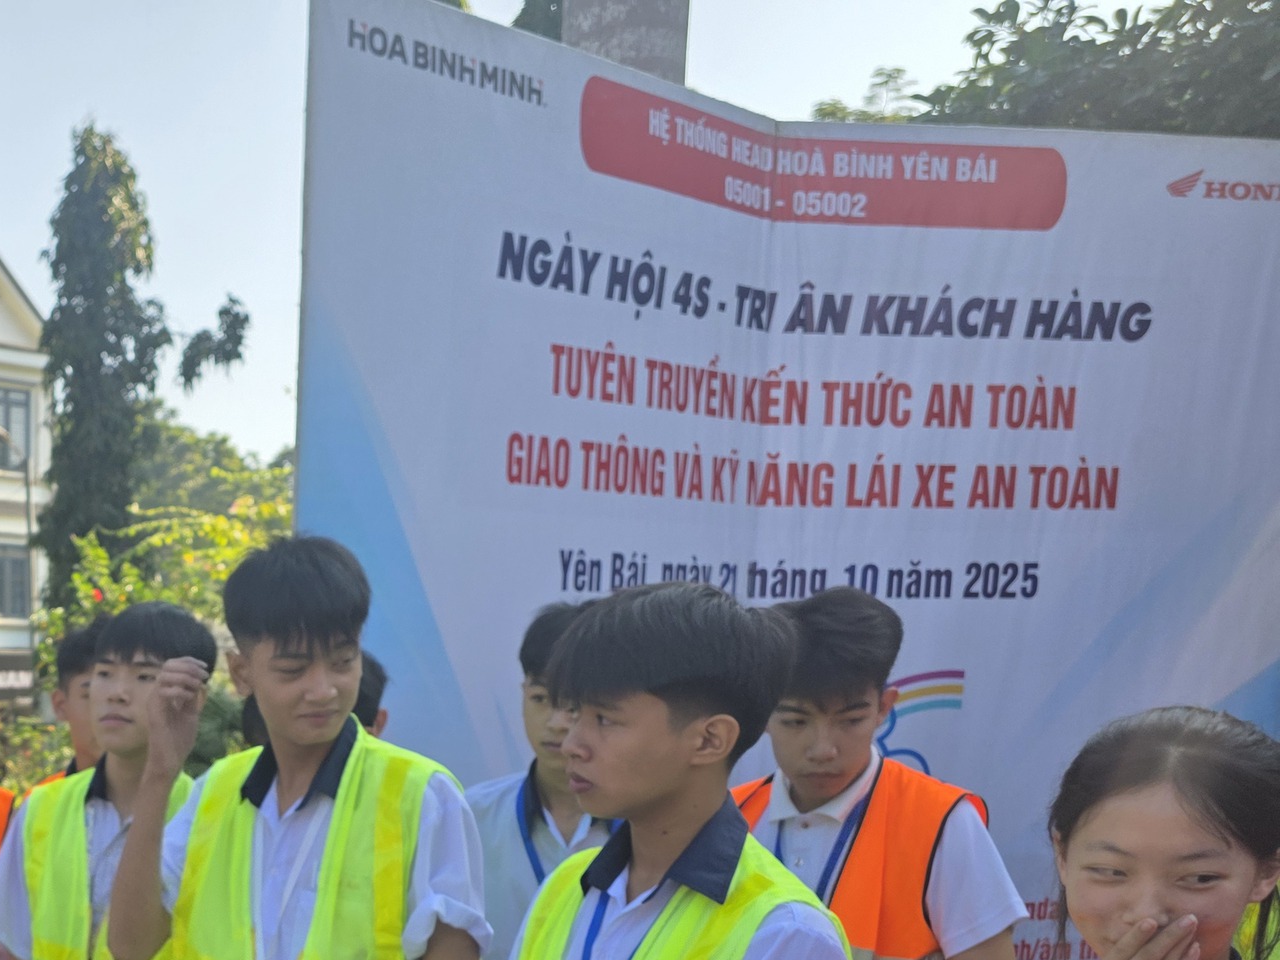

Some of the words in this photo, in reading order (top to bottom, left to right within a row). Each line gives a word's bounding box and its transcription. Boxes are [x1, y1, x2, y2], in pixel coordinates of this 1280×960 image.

[348, 19, 408, 65] HOA
[479, 60, 544, 106] MINH
[648, 107, 671, 146] HỆ
[674, 111, 728, 159] THỐNG
[732, 138, 773, 173] HEAD
[776, 147, 825, 178] HOÀ
[833, 147, 893, 180] BÌNH
[901, 149, 949, 182] YÊN
[955, 152, 998, 184] BÁI
[724, 175, 772, 212] 05001
[793, 190, 868, 218] 05002
[1202, 181, 1280, 201] HON
[497, 230, 601, 296] NGÀY
[606, 249, 668, 319] HỘI
[672, 271, 713, 320] 4S
[735, 283, 777, 333] TRI
[782, 280, 852, 335] ÂN
[860, 283, 1018, 340] KHÁCH
[1023, 287, 1154, 343] HÀNG
[550, 341, 636, 406] TUYÊN
[822, 372, 912, 428] THỨC
[923, 383, 972, 430] AN
[986, 375, 1077, 432] TOÀN
[505, 432, 570, 489] GIAO
[579, 434, 665, 498] THÔNG
[673, 441, 703, 501] VÀ
[846, 454, 900, 509] LÁI
[912, 463, 955, 509] XE
[967, 464, 1017, 510] AN
[1028, 459, 1120, 511] TOÀN
[559, 549, 602, 592] Yên
[611, 551, 647, 589] Bái
[747, 559, 827, 599] háng
[886, 560, 953, 599] năm
[963, 562, 1039, 599] 2025
